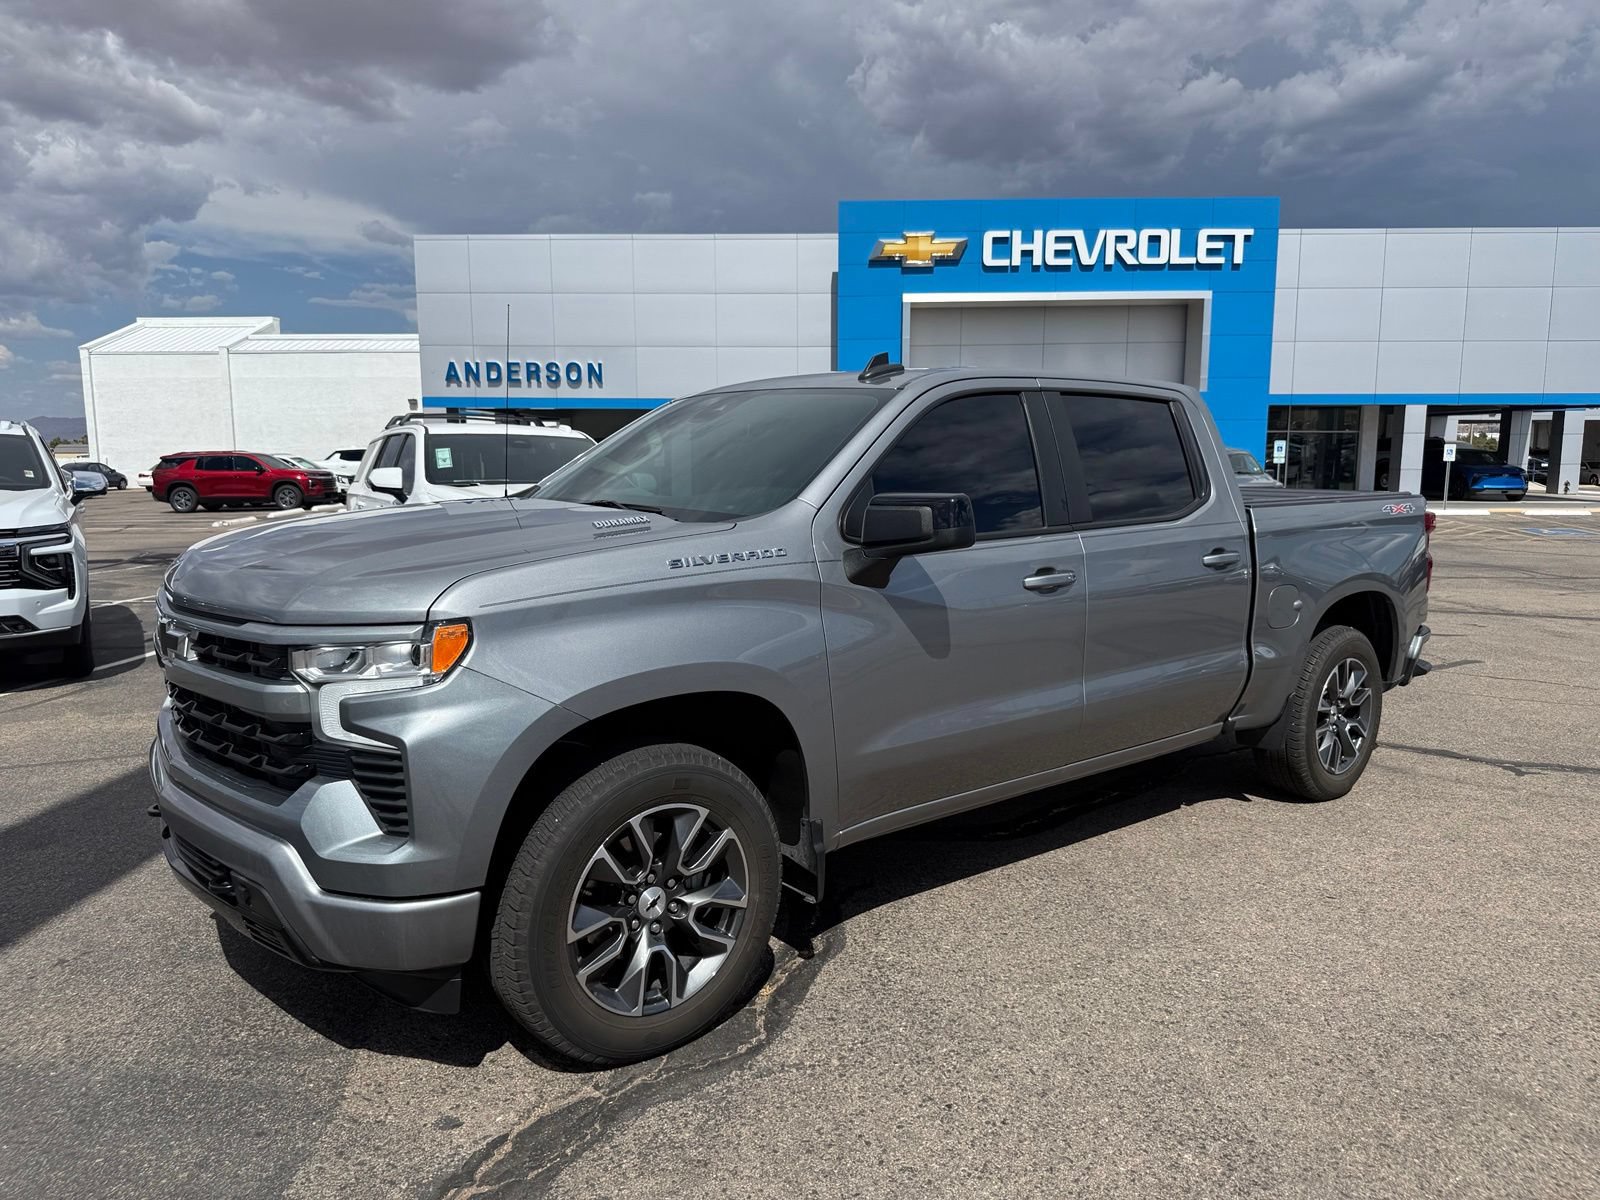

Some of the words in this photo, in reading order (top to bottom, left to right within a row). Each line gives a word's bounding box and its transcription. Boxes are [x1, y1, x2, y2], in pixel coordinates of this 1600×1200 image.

[982, 228, 1254, 268] CHEVROLET
[445, 360, 603, 384] ANDERSON
[593, 515, 650, 529] DURAMAX
[666, 548, 787, 569] SILVERADO
